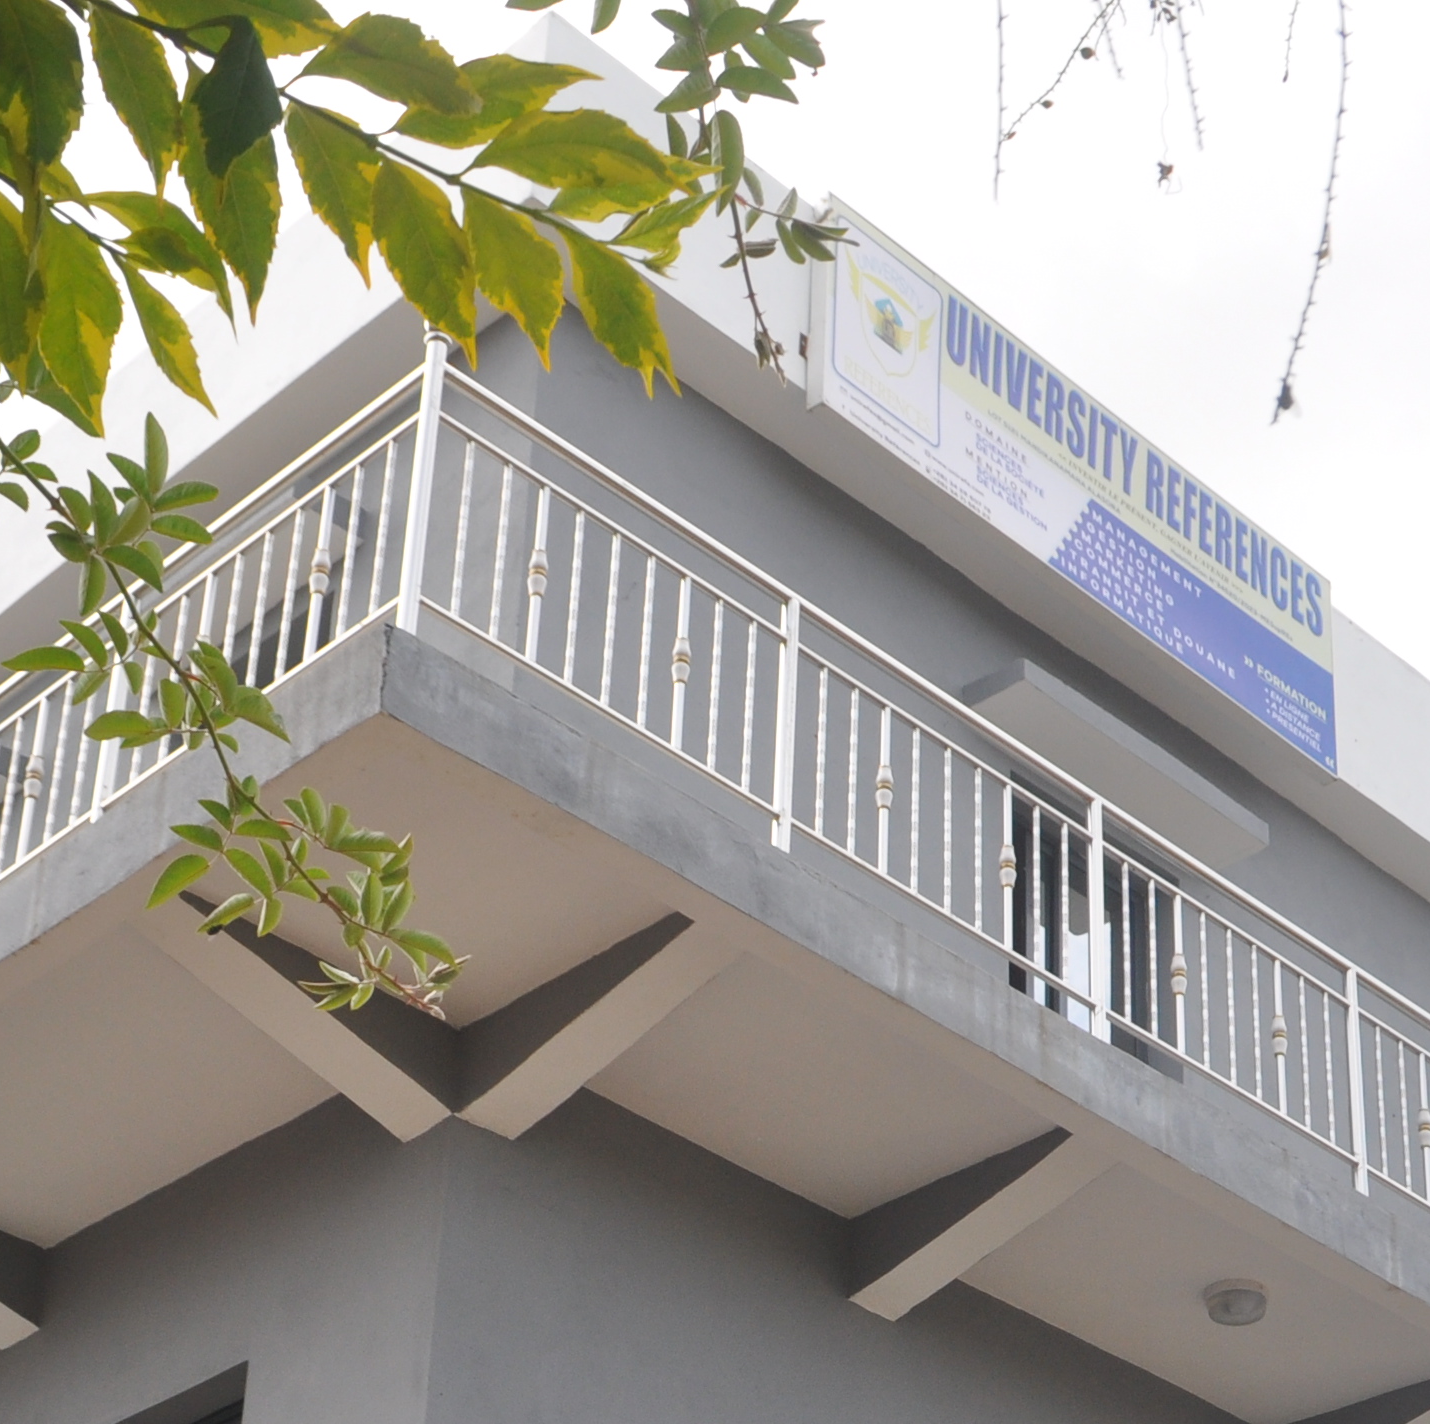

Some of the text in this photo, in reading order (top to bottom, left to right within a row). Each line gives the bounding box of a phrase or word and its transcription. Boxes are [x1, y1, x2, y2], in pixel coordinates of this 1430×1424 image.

[856, 252, 924, 309] UNIVERSITY
[966, 412, 1026, 462] DOMAINE
[976, 442, 987, 454] DE
[991, 453, 1002, 465] LA
[977, 434, 1022, 471] SCIENCES
[946, 293, 1323, 638] UNIVERSITY REFERENCES
[966, 448, 1027, 496] MENTION
[977, 466, 1023, 503] SCIENCES
[977, 475, 1047, 529] DE LA GESTION
[1075, 539, 1163, 610] COMMERCE
[1082, 532, 1173, 605] MARKETING
[1087, 522, 1156, 578] GESTION
[1093, 511, 1202, 598] MANAGEMENT
[1061, 557, 1183, 653] INFORMATIQUE
[1070, 550, 1138, 605] TRANSIT
[1148, 607, 1164, 626] ET
[1174, 627, 1235, 678] DOUANE
[1257, 666, 1326, 720] FORMATION
[1270, 689, 1309, 722] EN LIGNE
[1272, 711, 1321, 751] PRESENTIEL
[1279, 706, 1321, 740] DISTANCE
